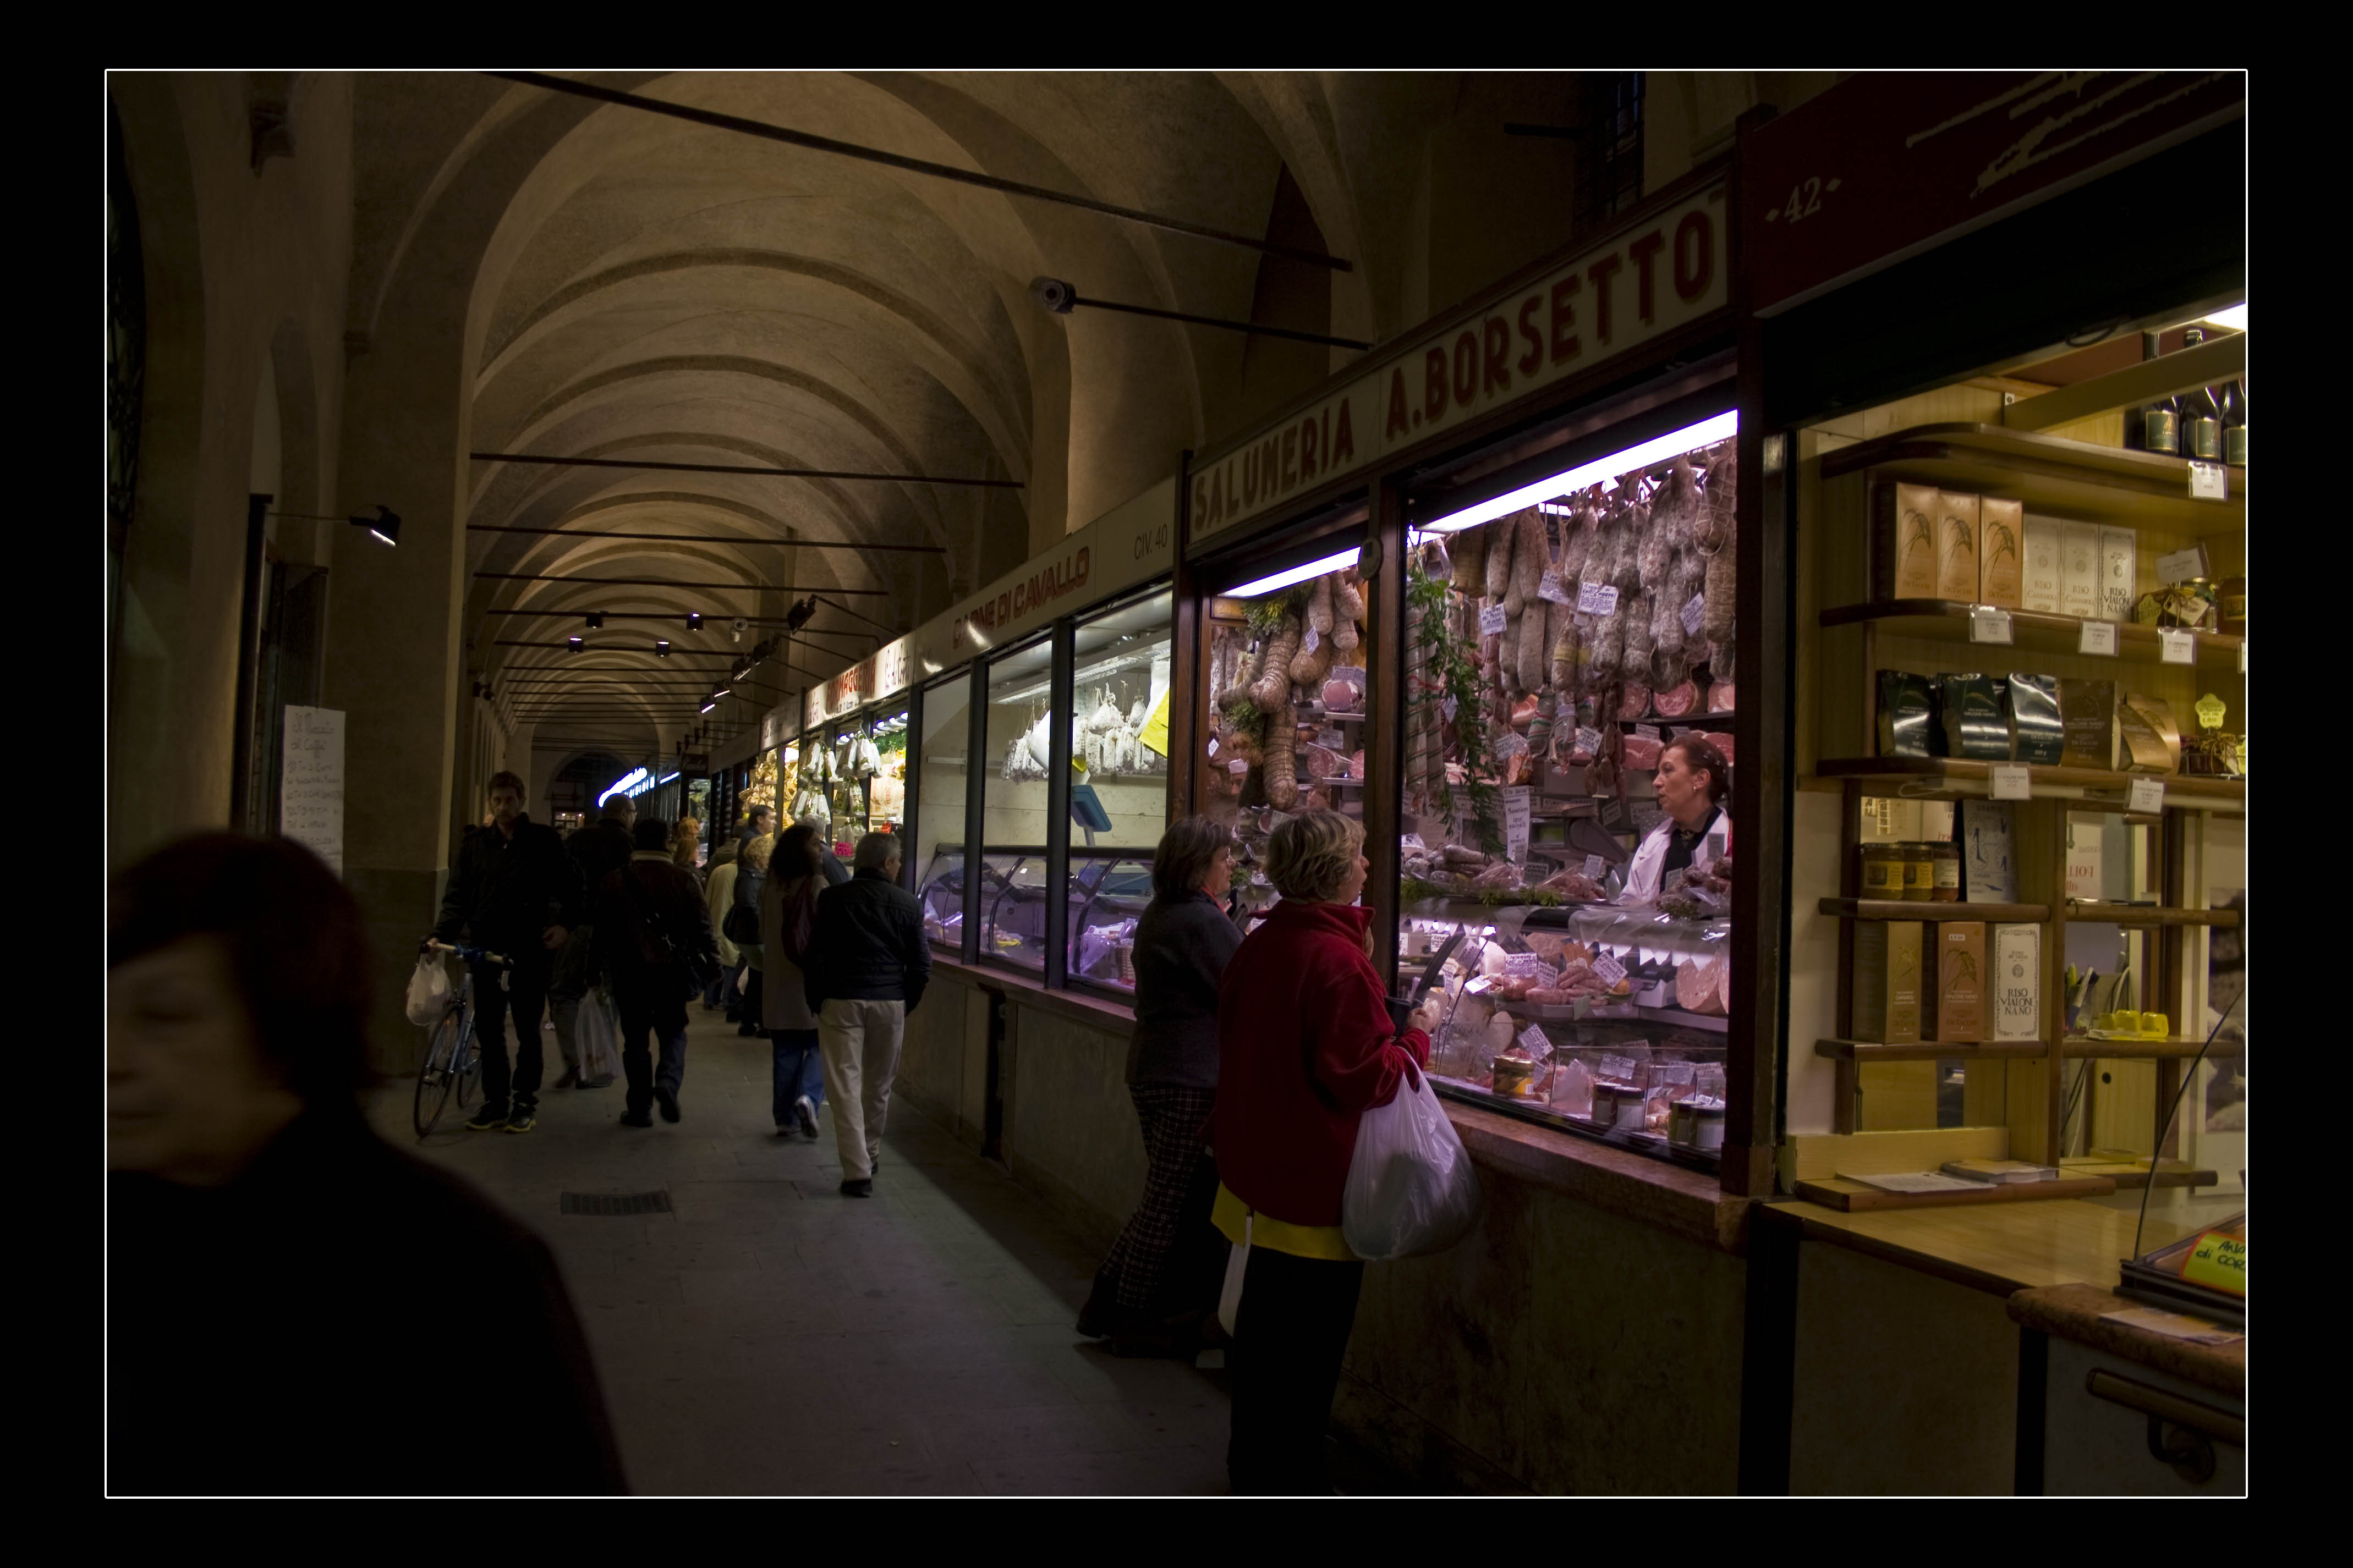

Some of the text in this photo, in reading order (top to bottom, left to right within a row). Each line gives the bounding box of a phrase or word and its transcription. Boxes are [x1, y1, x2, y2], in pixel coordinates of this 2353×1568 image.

[1782, 175, 1822, 224] 42
[1194, 397, 1354, 532] SALUMERIA
[1134, 524, 1168, 560] CIV. 40
[997, 591, 1012, 628] DI
[1013, 546, 1090, 620] CAVALLO
[2034, 580, 2052, 590] RISO
[2072, 585, 2089, 595] RISO
[2109, 587, 2126, 597] RISO
[2008, 988, 2028, 998] RISO
[2000, 997, 2033, 1006] VIALONE
[2004, 1006, 2031, 1016] NANO
[2196, 1248, 2213, 1259] di
